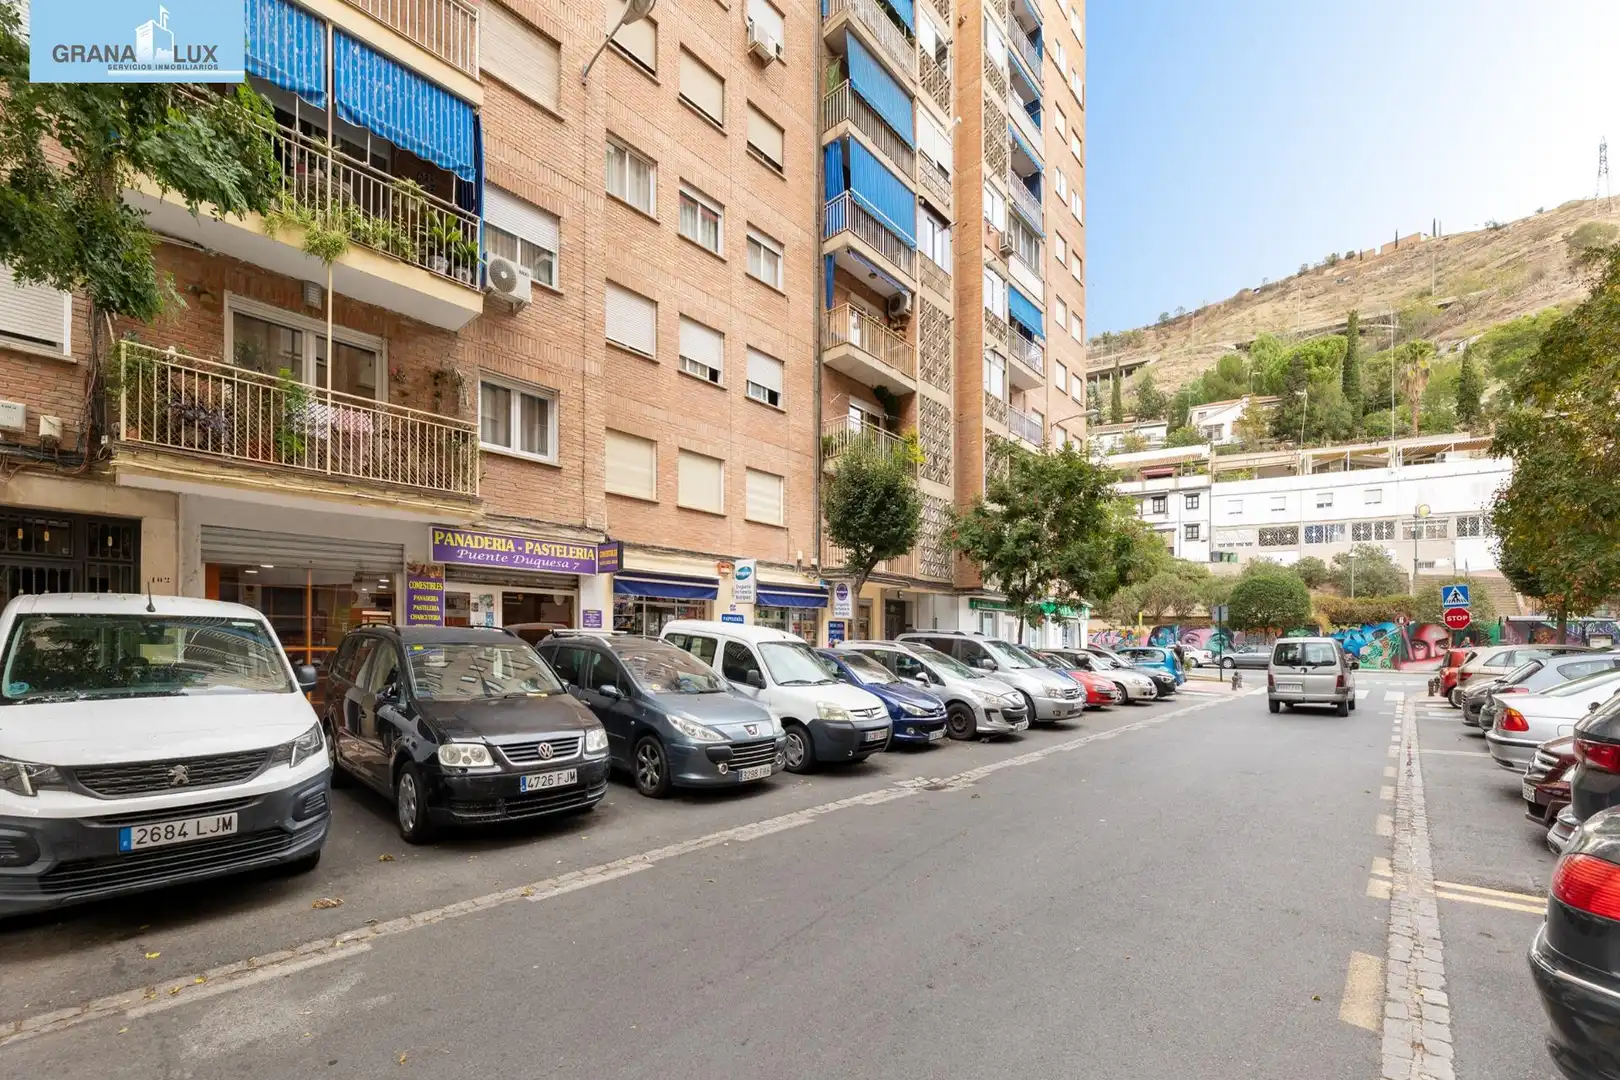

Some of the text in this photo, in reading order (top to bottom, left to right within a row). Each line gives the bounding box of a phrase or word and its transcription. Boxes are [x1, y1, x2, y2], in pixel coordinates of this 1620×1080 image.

[434, 530, 515, 553] PANADERIA
[525, 541, 595, 561] PASTELERIA
[457, 549, 580, 570] Puente Duquesa 7
[528, 771, 576, 789] 4726 FJM
[135, 815, 233, 845] 2684 LJM
